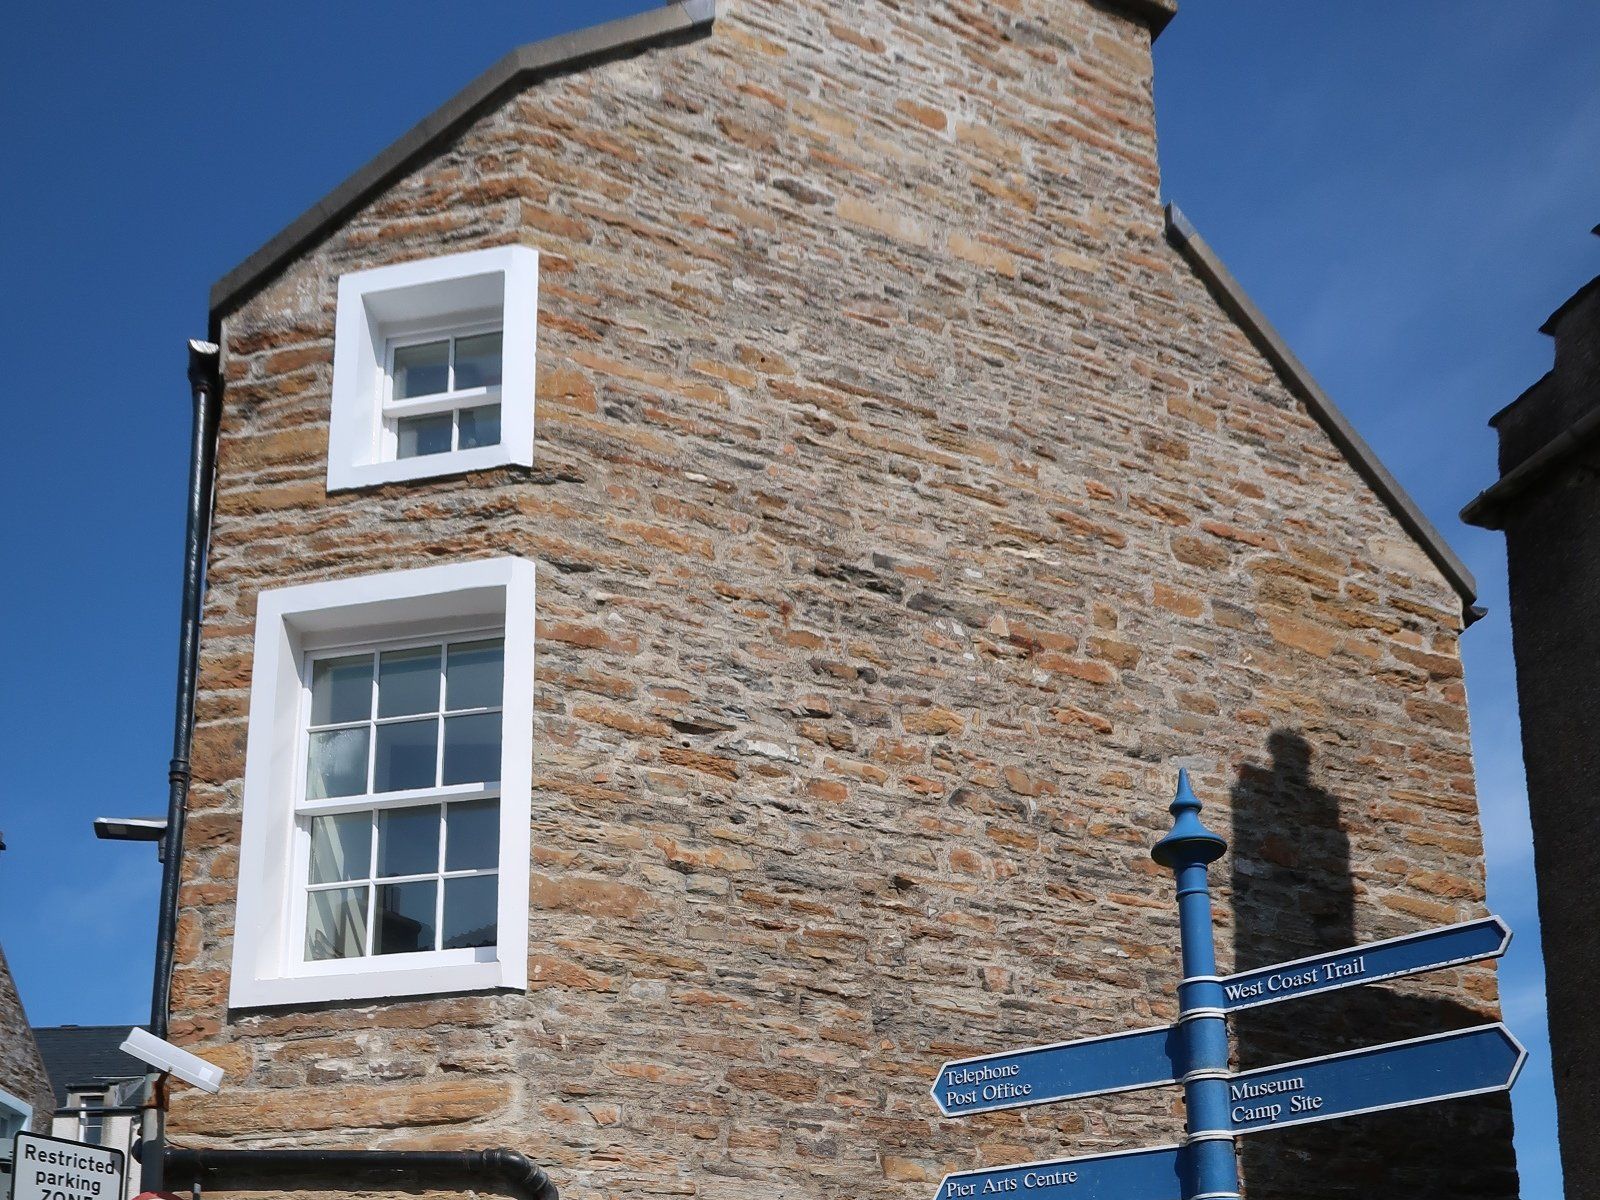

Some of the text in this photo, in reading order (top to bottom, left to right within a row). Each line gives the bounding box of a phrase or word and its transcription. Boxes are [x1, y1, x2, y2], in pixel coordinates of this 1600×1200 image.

[1225, 957, 1366, 1000] West Coast Trail
[945, 1064, 1019, 1086] Telephone
[946, 1083, 1032, 1107] Post Office
[1231, 1077, 1305, 1101] Museum
[1231, 1095, 1324, 1122] Camp Site
[25, 1144, 115, 1175] Restricted
[36, 1171, 101, 1195] parking
[946, 1171, 1078, 1197] Pier Arts Centre
